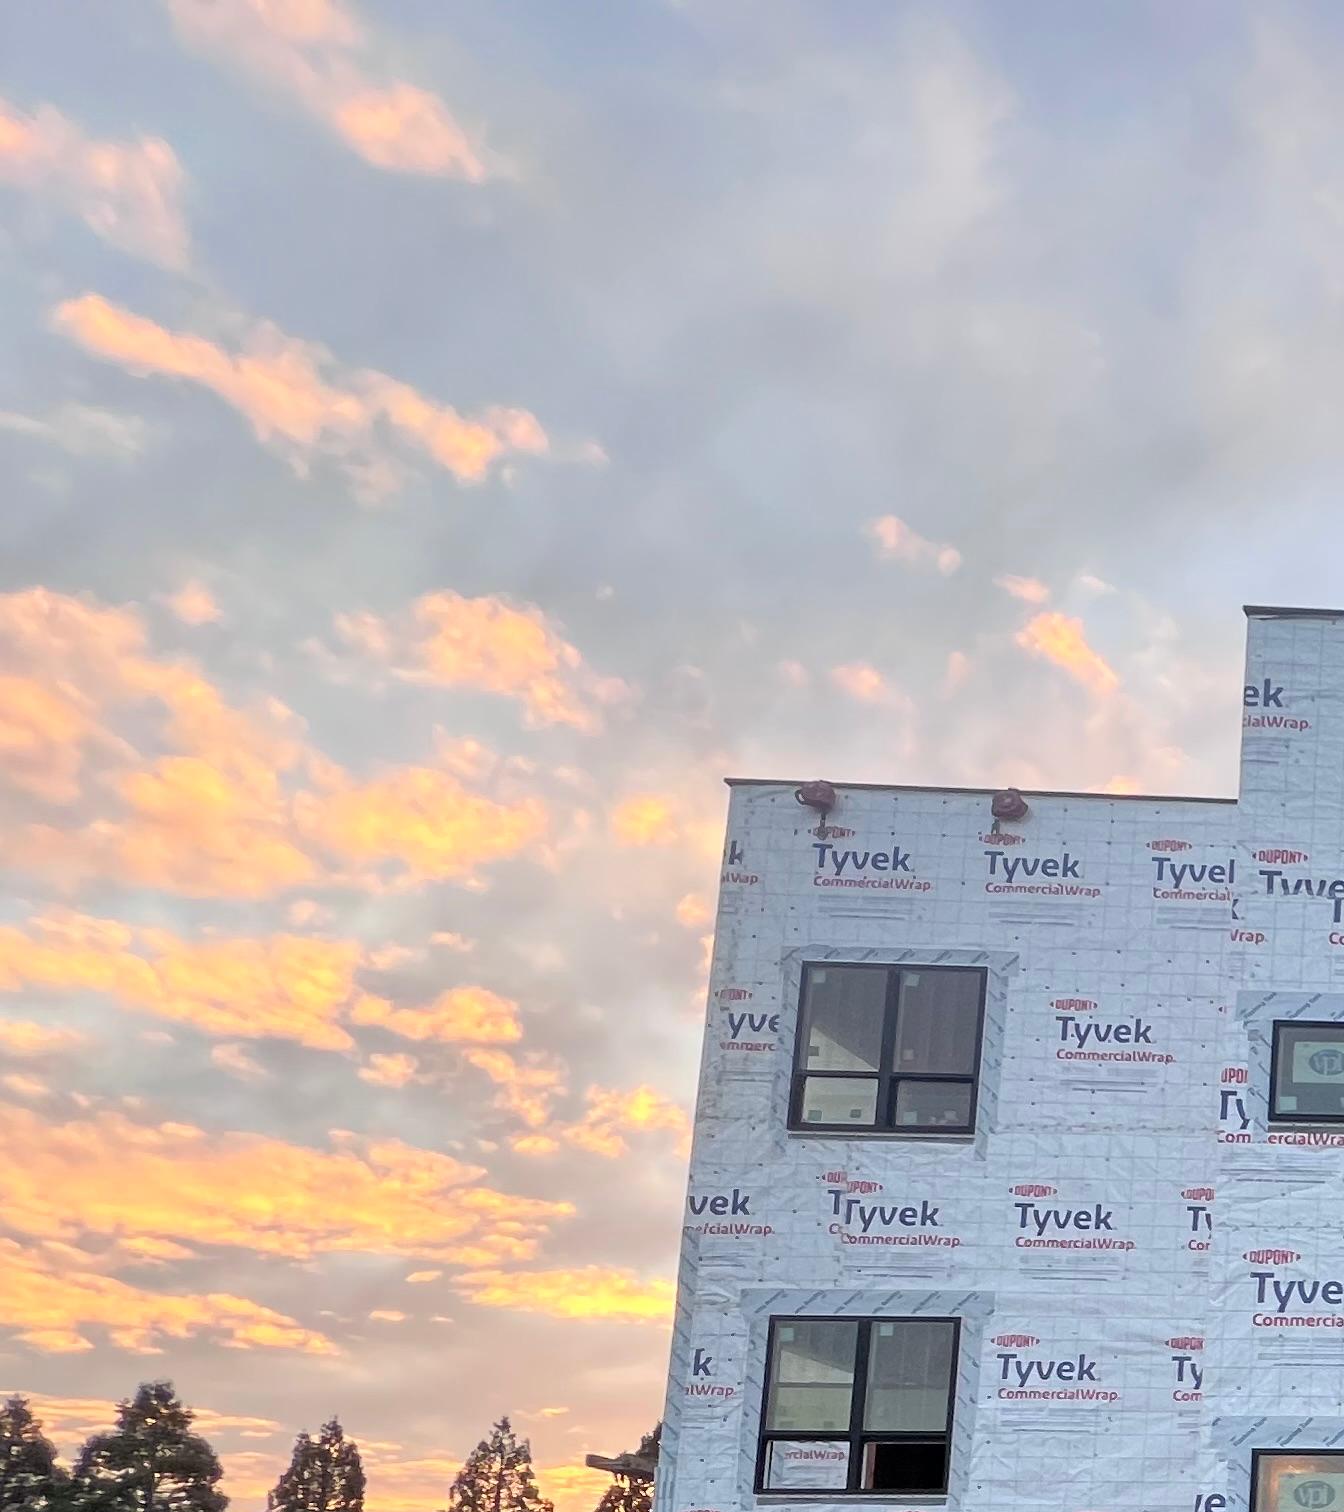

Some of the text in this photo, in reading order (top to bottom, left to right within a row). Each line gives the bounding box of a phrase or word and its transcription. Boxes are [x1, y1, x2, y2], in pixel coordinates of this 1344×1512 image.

[1057, 1016, 1151, 1048] Tyvek
[1016, 1203, 1113, 1236] Tyvek
[998, 1354, 1097, 1387] Tyvek
